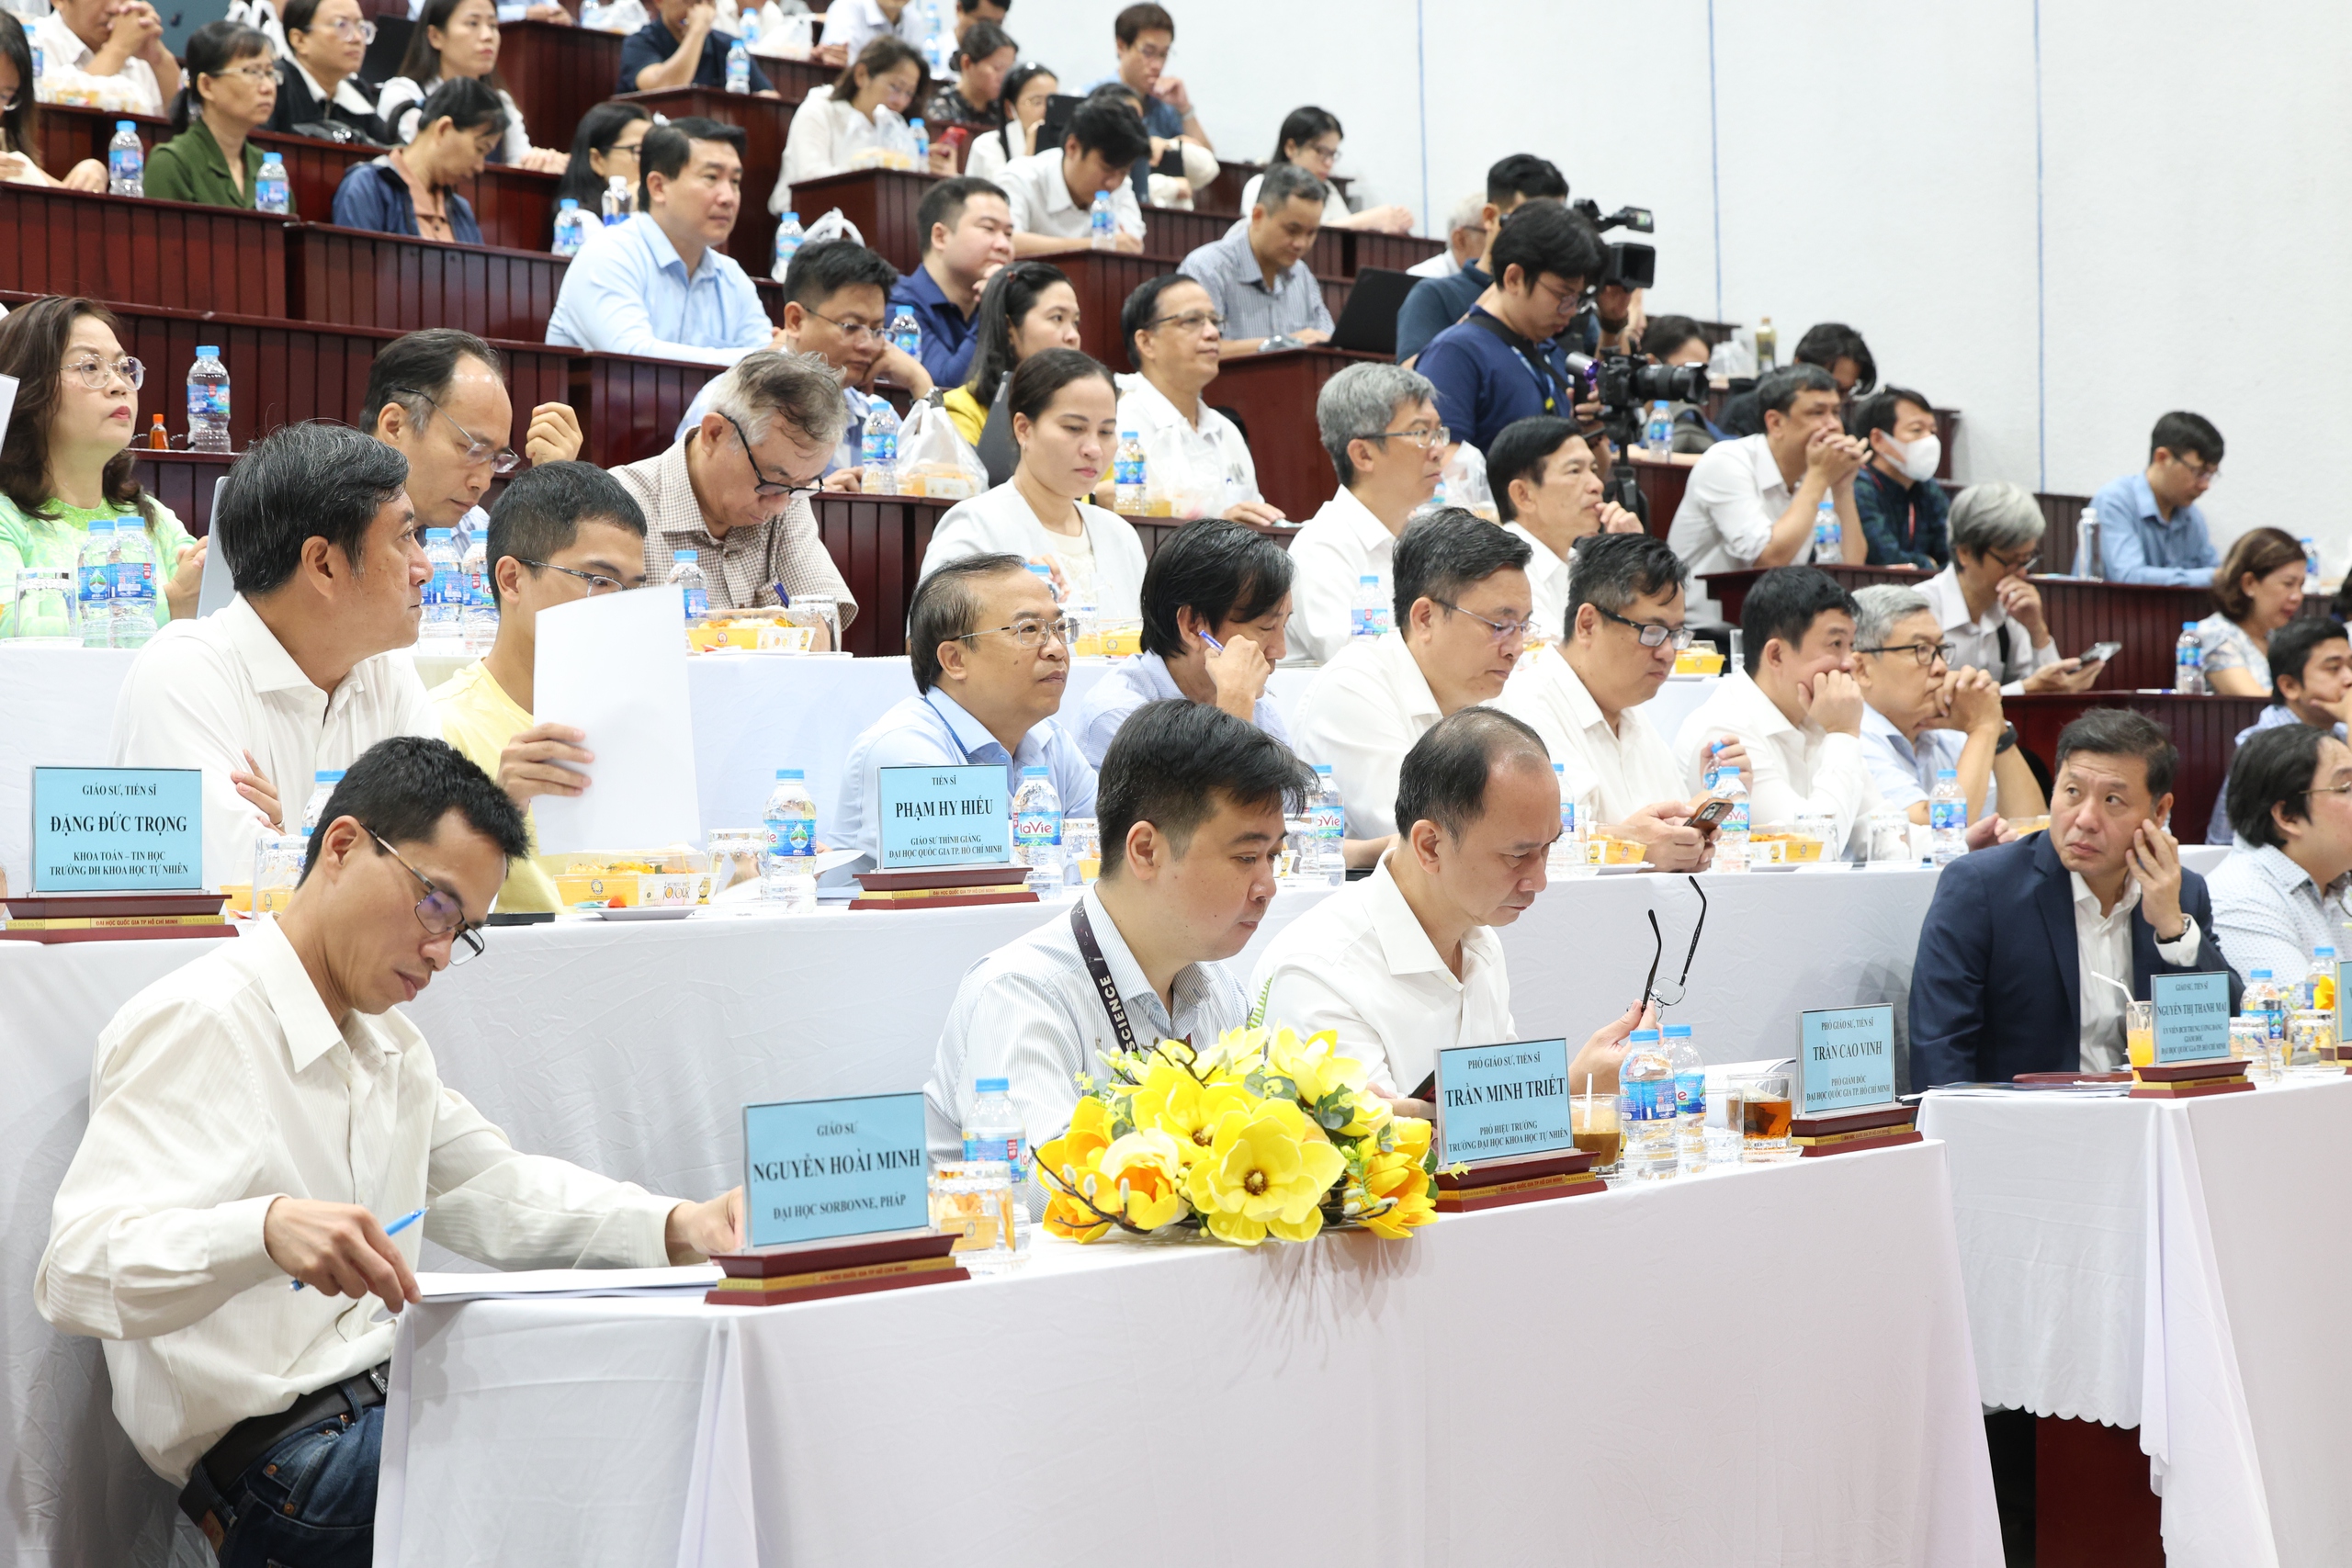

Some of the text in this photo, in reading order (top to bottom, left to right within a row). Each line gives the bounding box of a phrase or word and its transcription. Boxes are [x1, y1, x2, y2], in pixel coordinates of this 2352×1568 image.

[932, 775, 956, 785] TIẾN SĨ
[83, 783, 156, 797] GIÁO SƯ, TIẾN SĨ
[896, 795, 993, 821] PHẠM HY HIẾU
[1726, 811, 1747, 820] aVie
[51, 811, 187, 836] ĐẶNG ĐỨC TRỌNG
[1020, 822, 1052, 833] laVie
[1318, 815, 1340, 826] aVie
[911, 836, 927, 845] GIÁO
[929, 836, 938, 845] SƯ
[960, 833, 981, 843] GIẢNG
[74, 852, 98, 861] KHOA
[101, 849, 123, 861] TOÁN
[131, 852, 145, 860] TIN
[147, 851, 166, 862] HỌC
[889, 850, 901, 859] ĐẠI
[903, 849, 917, 859] HỌC
[919, 847, 937, 858] QUỐC
[951, 847, 960, 855] TP.
[972, 844, 984, 854] CHÍ
[50, 862, 188, 877] TRƯỜNG ĐH KHOA HỌC TỰ NHIÊN
[1100, 975, 1136, 1054] SCIENCE
[2183, 1004, 2193, 1016] THỊ
[2195, 1003, 2214, 1013] THANH
[2216, 1002, 2227, 1012] MAI
[1822, 1020, 1832, 1030] PHÓ
[1833, 1019, 1847, 1029] GIÁO
[1856, 1017, 1868, 1027] TIẾN
[1869, 1017, 1874, 1026] SĨ
[1813, 1041, 1882, 1061] TRẦN CAO VINH
[1468, 1057, 1483, 1069] PHÓ
[1484, 1055, 1503, 1068] GIÁO
[1516, 1052, 1533, 1064] TIẾN
[1534, 1051, 1540, 1063] SĨ
[1445, 1074, 1565, 1107] TRẦN MINH TRIẾT
[817, 1121, 858, 1136] GIÁO SƯ
[1480, 1124, 1493, 1135] PHÓ
[1494, 1123, 1510, 1136] HIỆU
[1449, 1127, 1568, 1152] TRƯỜNG ĐẠI HỌC KHOA HỌC TỰ NHIÊN
[753, 1149, 920, 1182] NGUYỄN HOÀI MINH
[774, 1192, 906, 1221] ĐẠI HỌC SORBONNE, PHÁP
